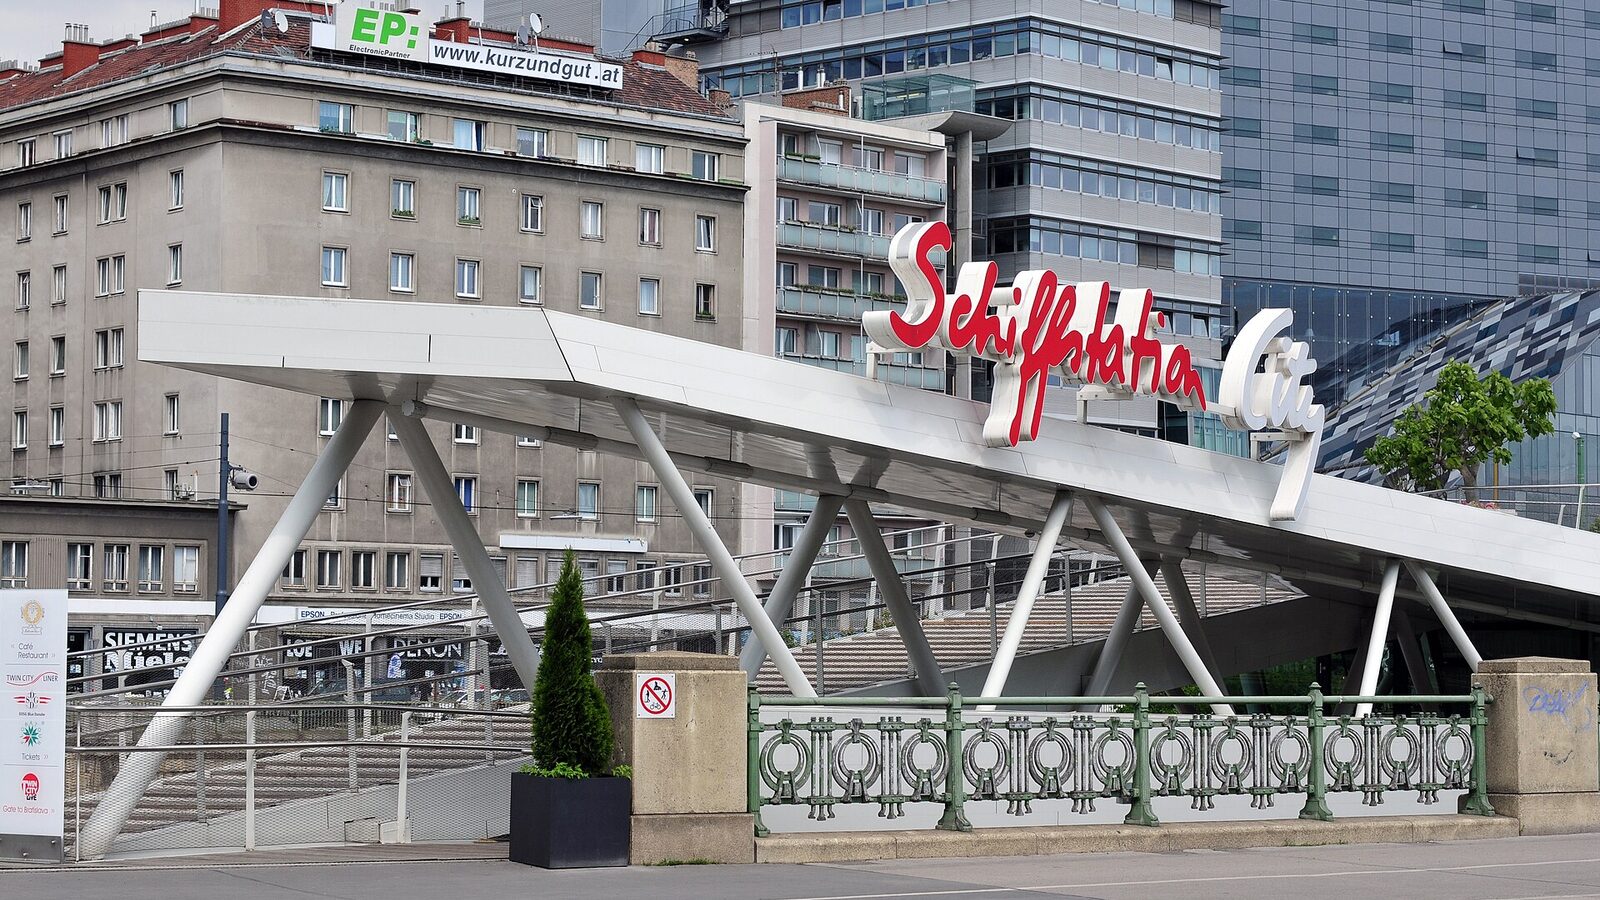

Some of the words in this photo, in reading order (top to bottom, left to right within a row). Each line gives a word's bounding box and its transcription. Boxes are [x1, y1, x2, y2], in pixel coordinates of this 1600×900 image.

[351, 8, 419, 49] EP:
[349, 44, 411, 58] ElectronicPartner
[887, 221, 1207, 447] Schiffstation
[1218, 307, 1325, 521] City
[105, 632, 192, 652] SIEMENS
[393, 637, 462, 658] DENON
[6, 674, 21, 682] TWIN
[22, 674, 34, 682] CITY
[21, 753, 41, 761] Tickets
[3, 805, 17, 813] Gate
[24, 806, 49, 814] Bratislava
